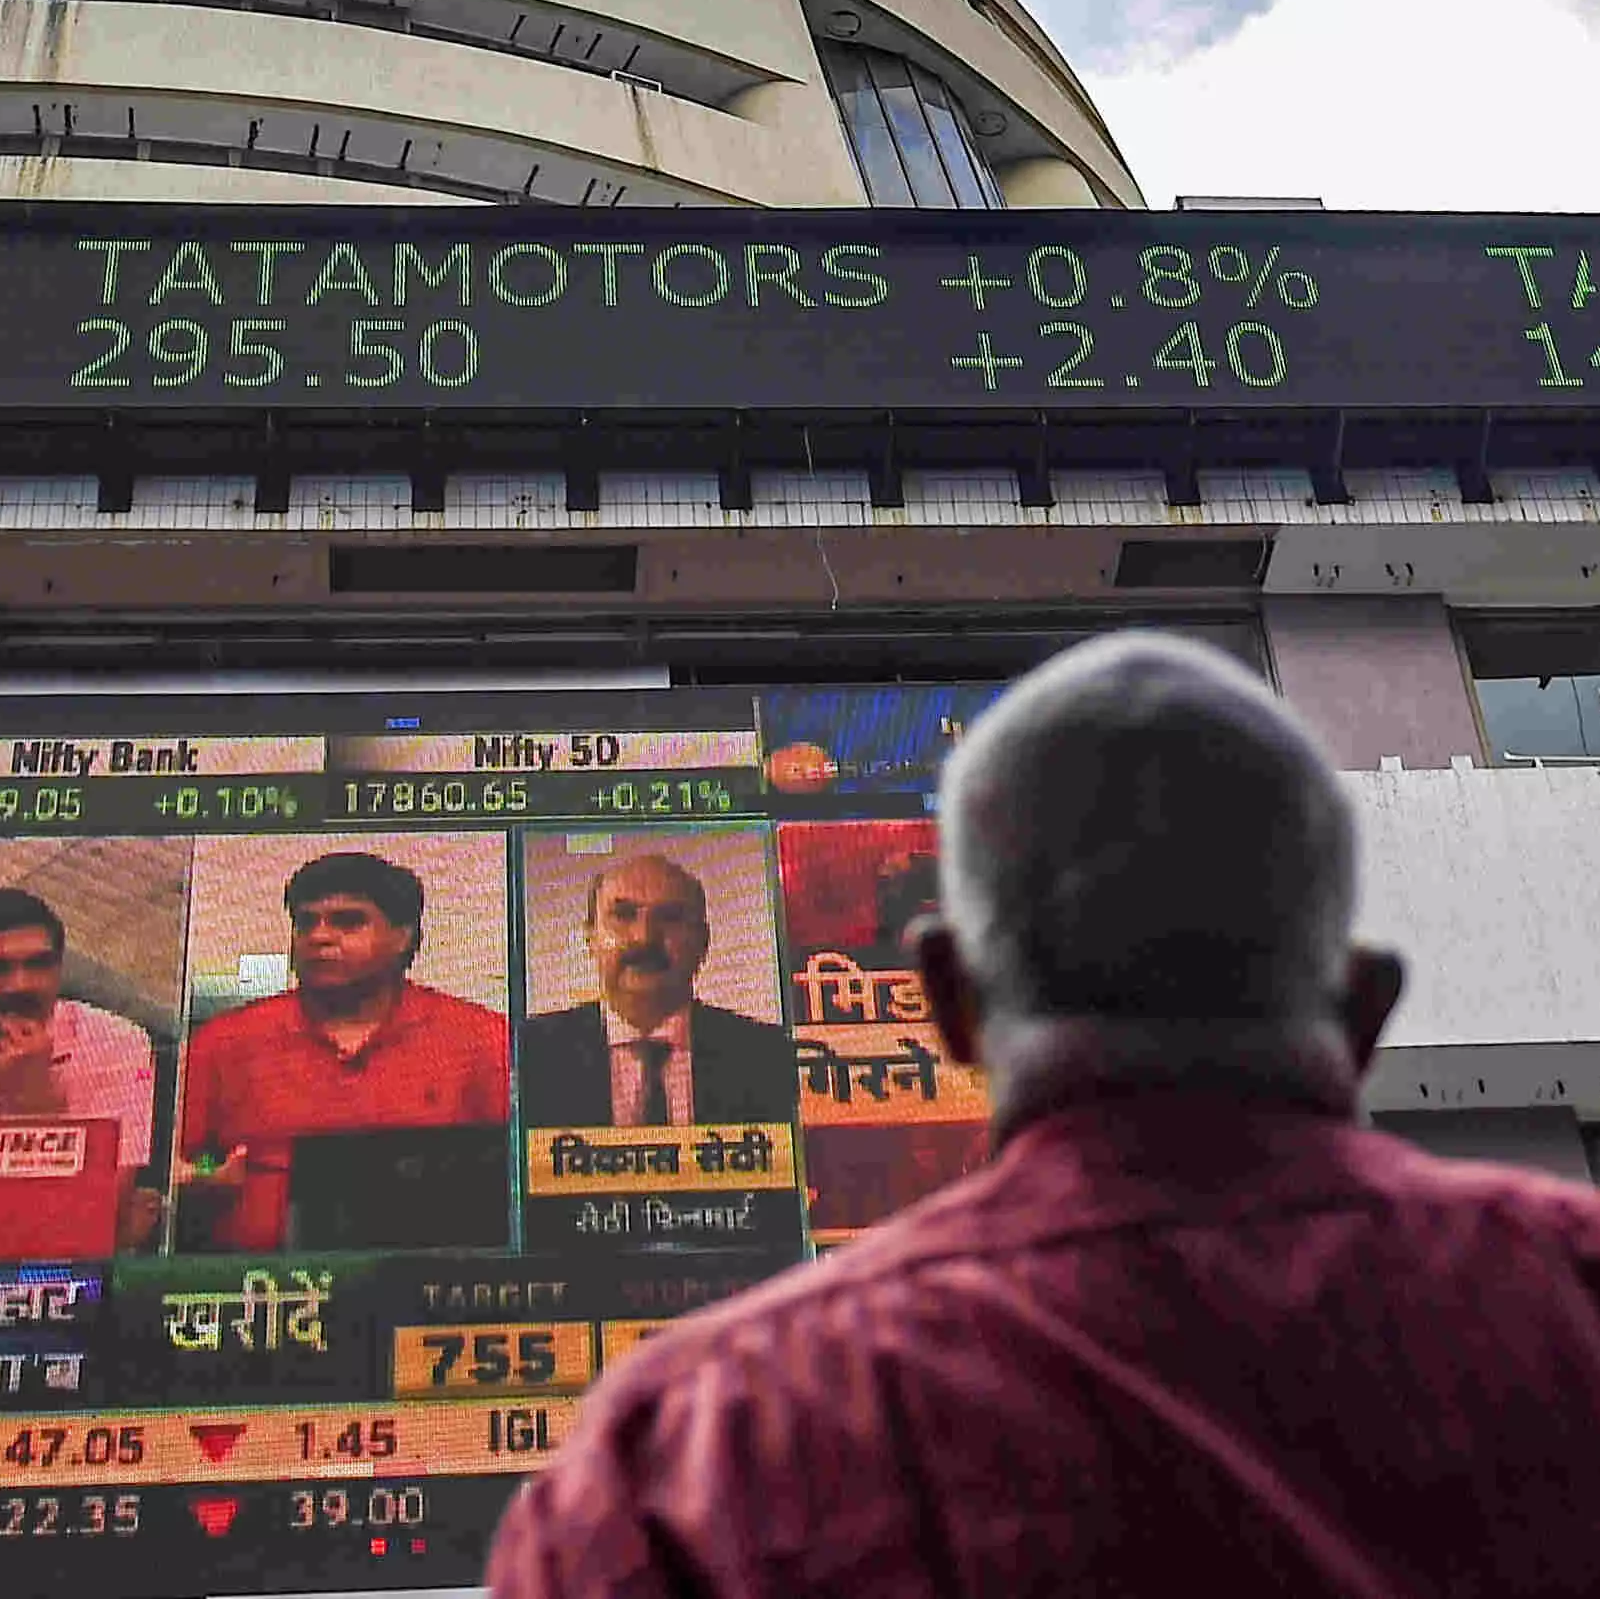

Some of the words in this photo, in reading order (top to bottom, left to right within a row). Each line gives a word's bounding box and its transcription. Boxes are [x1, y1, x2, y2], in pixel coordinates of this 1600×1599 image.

[73, 237, 890, 307] TATAMOTORS
[938, 243, 1321, 311] +0.8%
[69, 316, 480, 389] 295.50
[950, 320, 1289, 392] +2.40
[11, 740, 99, 777] Nifty
[109, 739, 200, 774] Bank
[473, 735, 556, 771] Nifty
[570, 734, 622, 767] 50
[154, 784, 300, 819] +0.10%
[343, 780, 529, 813] 17860.65
[589, 780, 733, 813] +0.21%
[550, 1133, 681, 1177] विकास
[162, 1268, 334, 1353] खरीदें
[422, 1281, 570, 1310] TARGET
[422, 1331, 557, 1386] 755
[5, 1426, 145, 1467] 47.05
[295, 1419, 397, 1460] 1.45
[290, 1486, 425, 1529] 39.00
